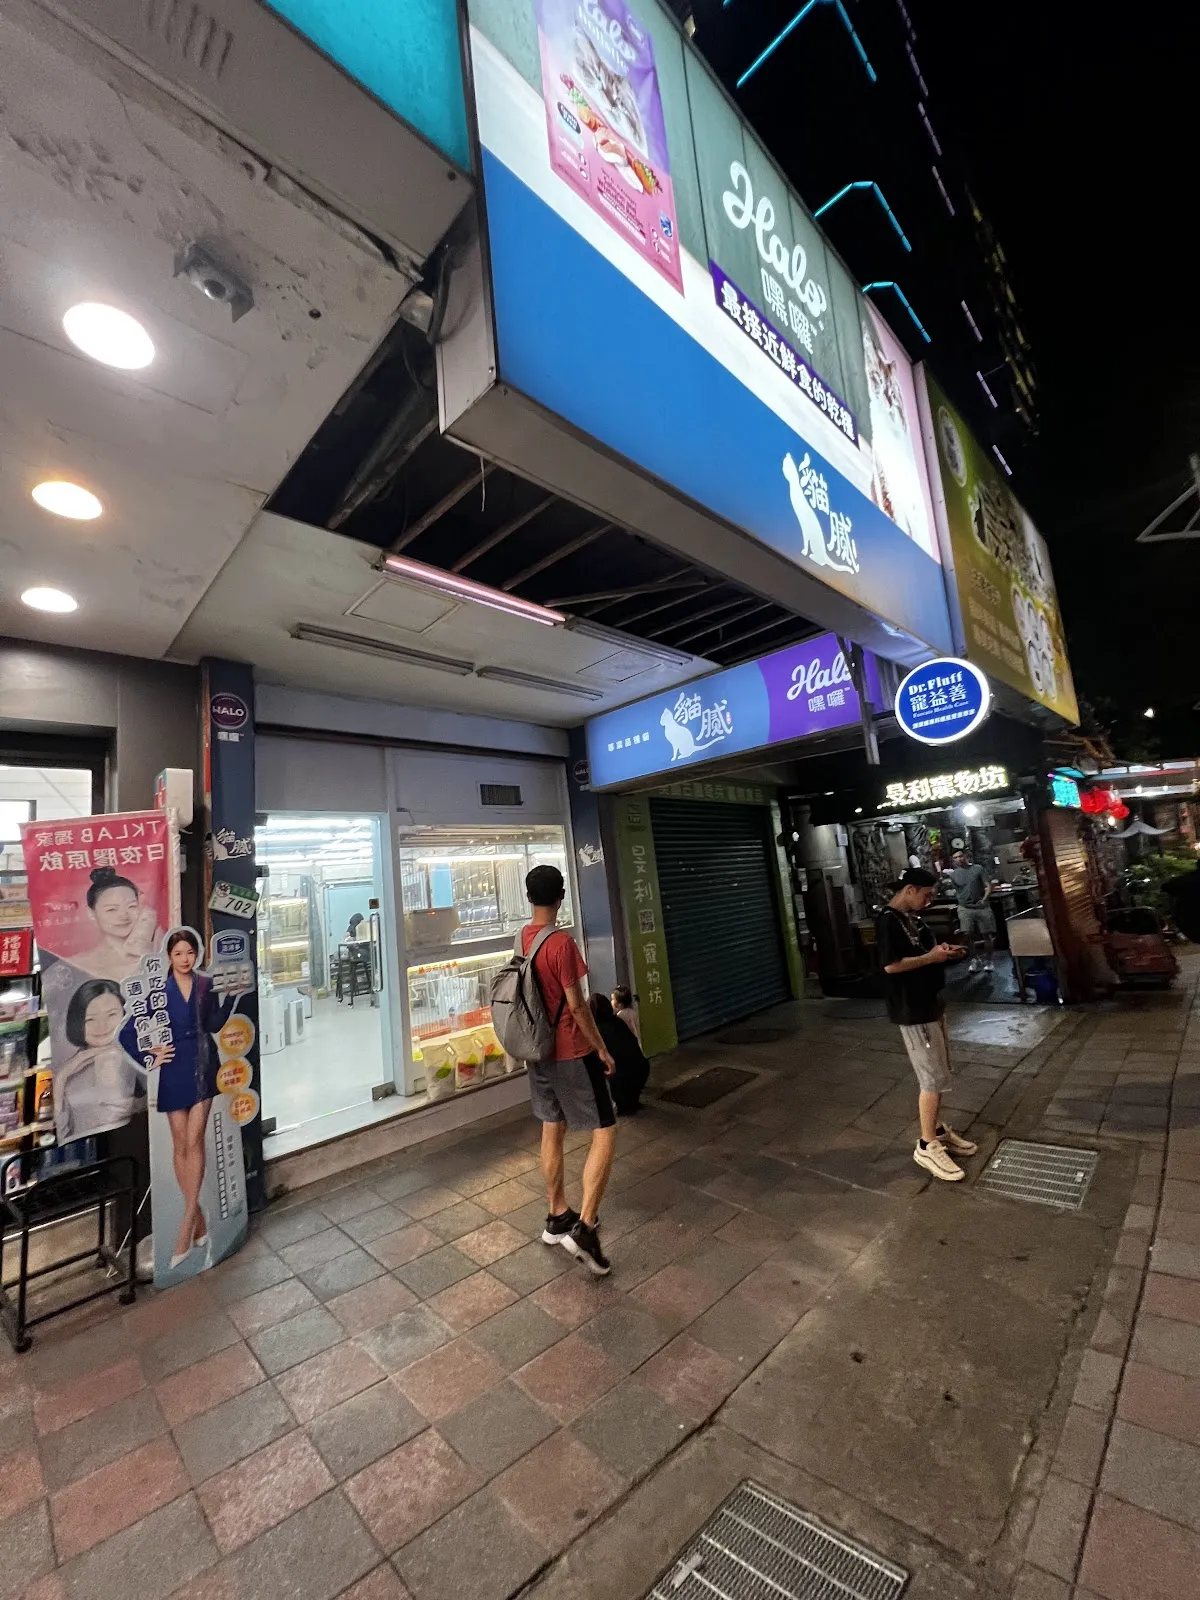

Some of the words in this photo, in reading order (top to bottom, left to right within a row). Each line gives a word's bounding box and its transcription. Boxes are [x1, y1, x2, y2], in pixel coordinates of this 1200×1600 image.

[722, 160, 827, 318] Halo
[721, 280, 856, 441] 最接近鮮食的乾糧
[908, 671, 963, 696] Dr.Fluff
[909, 683, 967, 713] 寵益善
[212, 705, 245, 717] HALO
[224, 897, 252, 914] 702
[642, 942, 663, 1005] 寵物坊
[146, 958, 171, 1043] 你吃的魚油
